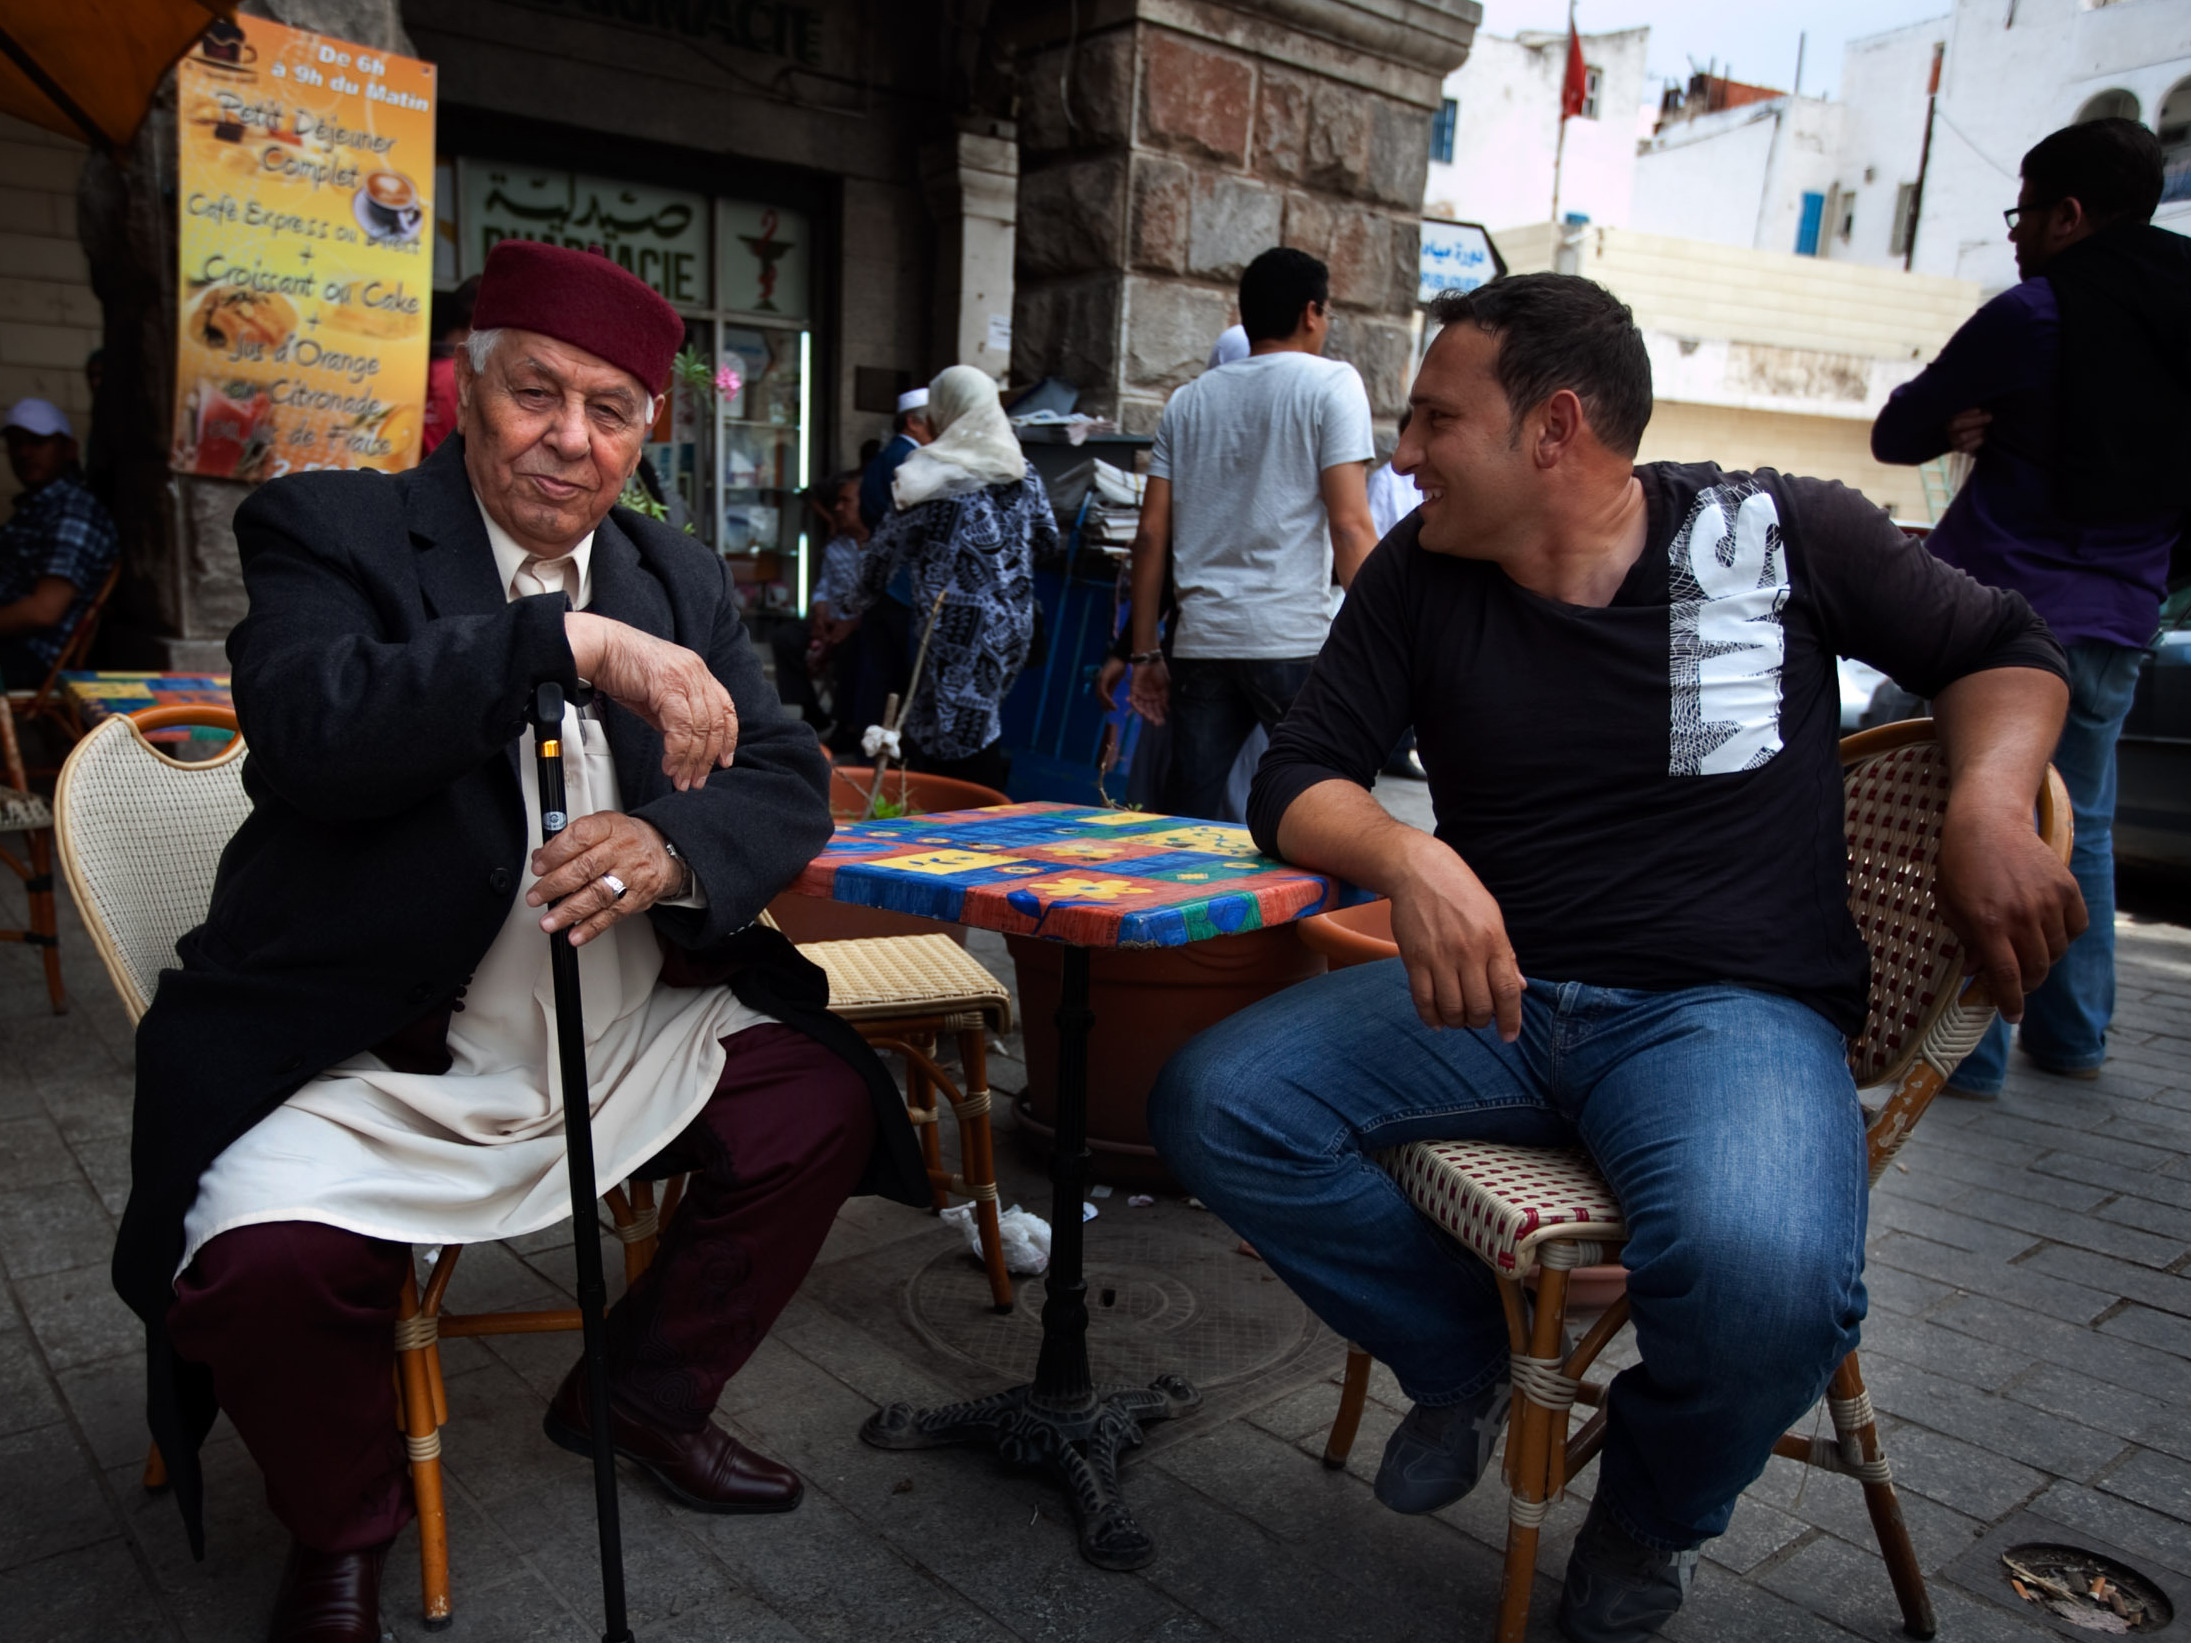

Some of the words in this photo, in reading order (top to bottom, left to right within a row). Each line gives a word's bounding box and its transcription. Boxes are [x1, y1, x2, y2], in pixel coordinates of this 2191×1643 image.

[319, 45, 351, 67] De
[356, 56, 385, 76] 6h
[214, 91, 284, 130] Petit
[294, 65, 323, 87] 9h
[330, 75, 359, 96] du
[365, 82, 429, 112] Matin
[262, 146, 360, 191] Complet
[186, 193, 238, 226] Café
[243, 200, 330, 238] Express
[335, 226, 358, 244] ou
[203, 254, 317, 298] Croissant
[323, 283, 353, 306] ou
[361, 282, 421, 315] Cake
[227, 330, 264, 363] Jus
[273, 332, 381, 384] d'Orange
[268, 378, 383, 417] Citronade
[288, 420, 316, 446] de
